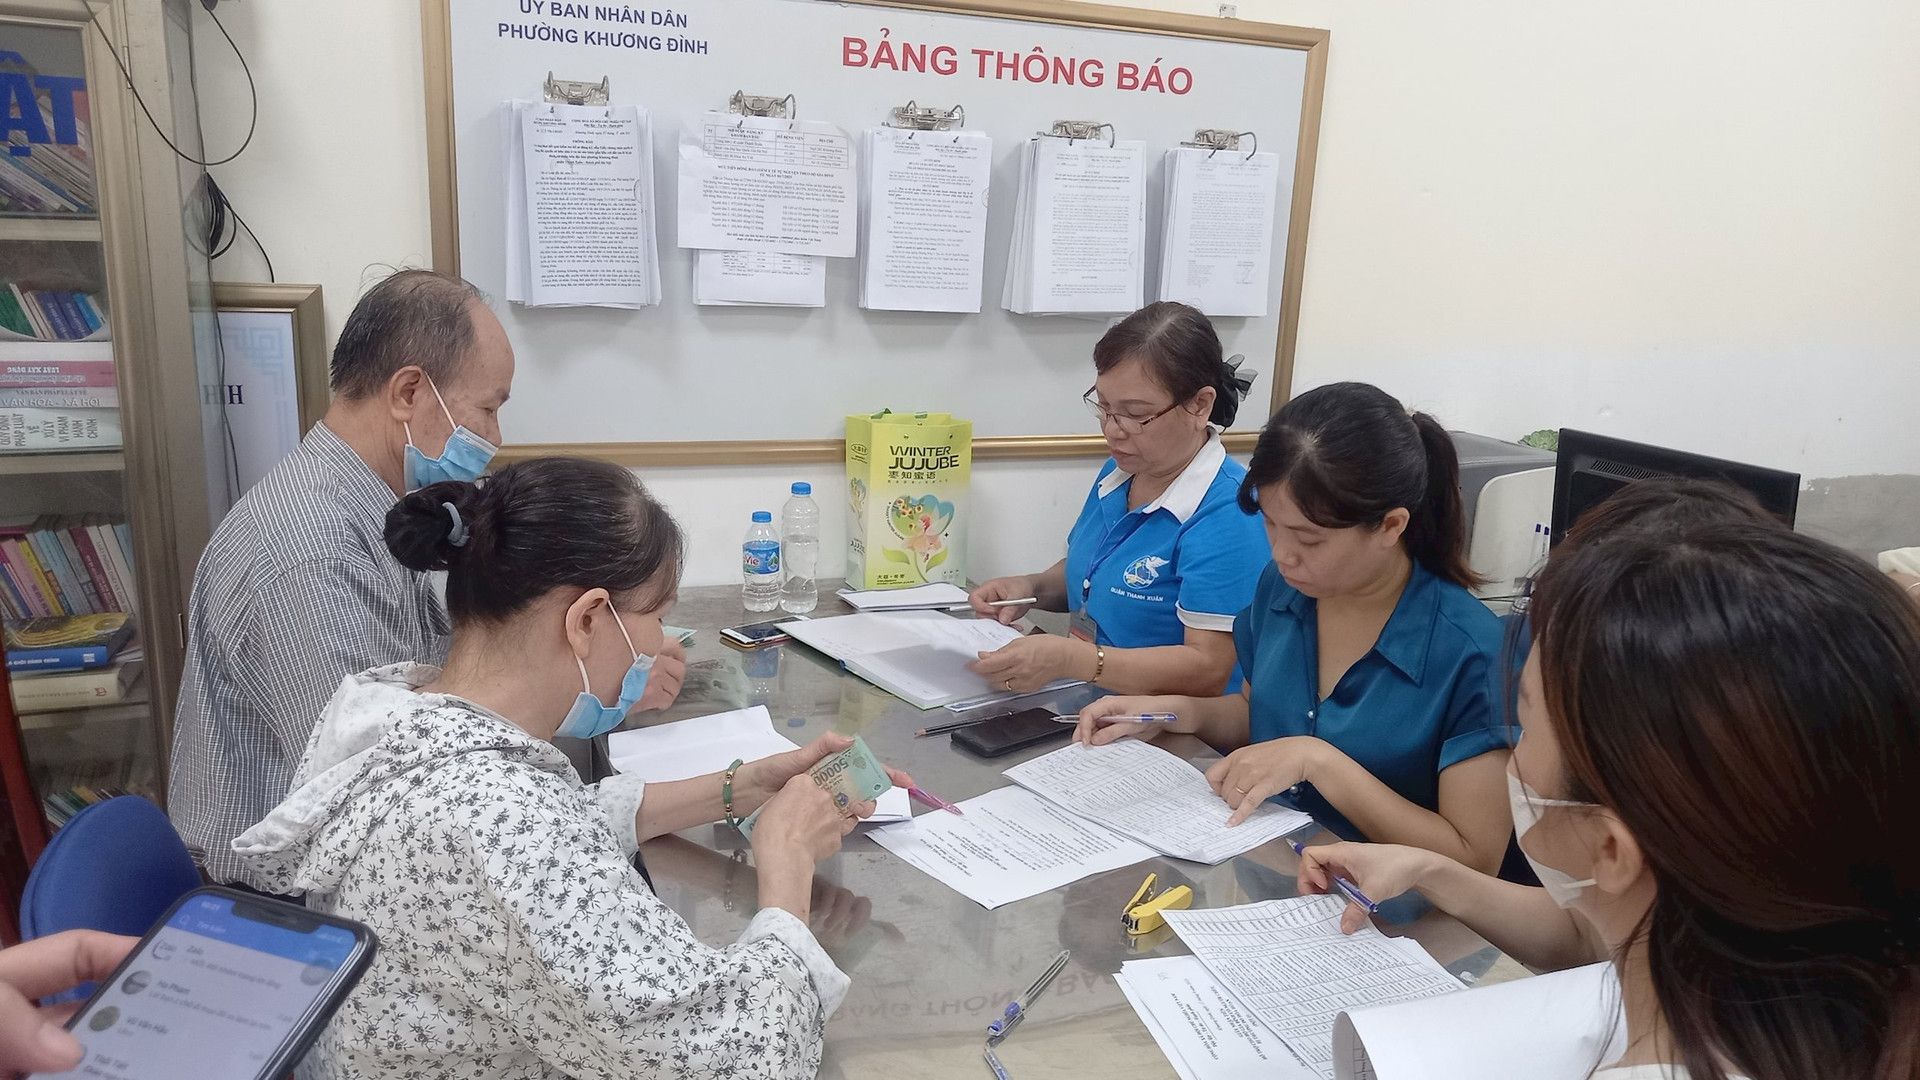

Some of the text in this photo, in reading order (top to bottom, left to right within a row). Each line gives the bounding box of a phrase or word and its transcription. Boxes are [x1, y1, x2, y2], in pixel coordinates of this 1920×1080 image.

[551, 2, 589, 20] BAN
[595, 5, 645, 25] NHÂN
[651, 9, 687, 28] DÂN
[498, 22, 708, 55] PHƯỜNG KHƯƠNG ĐÌNH
[842, 27, 1193, 95] BẢNG THÔNG BÁO
[889, 445, 951, 456] WINTER
[889, 455, 960, 470] JUJUBE
